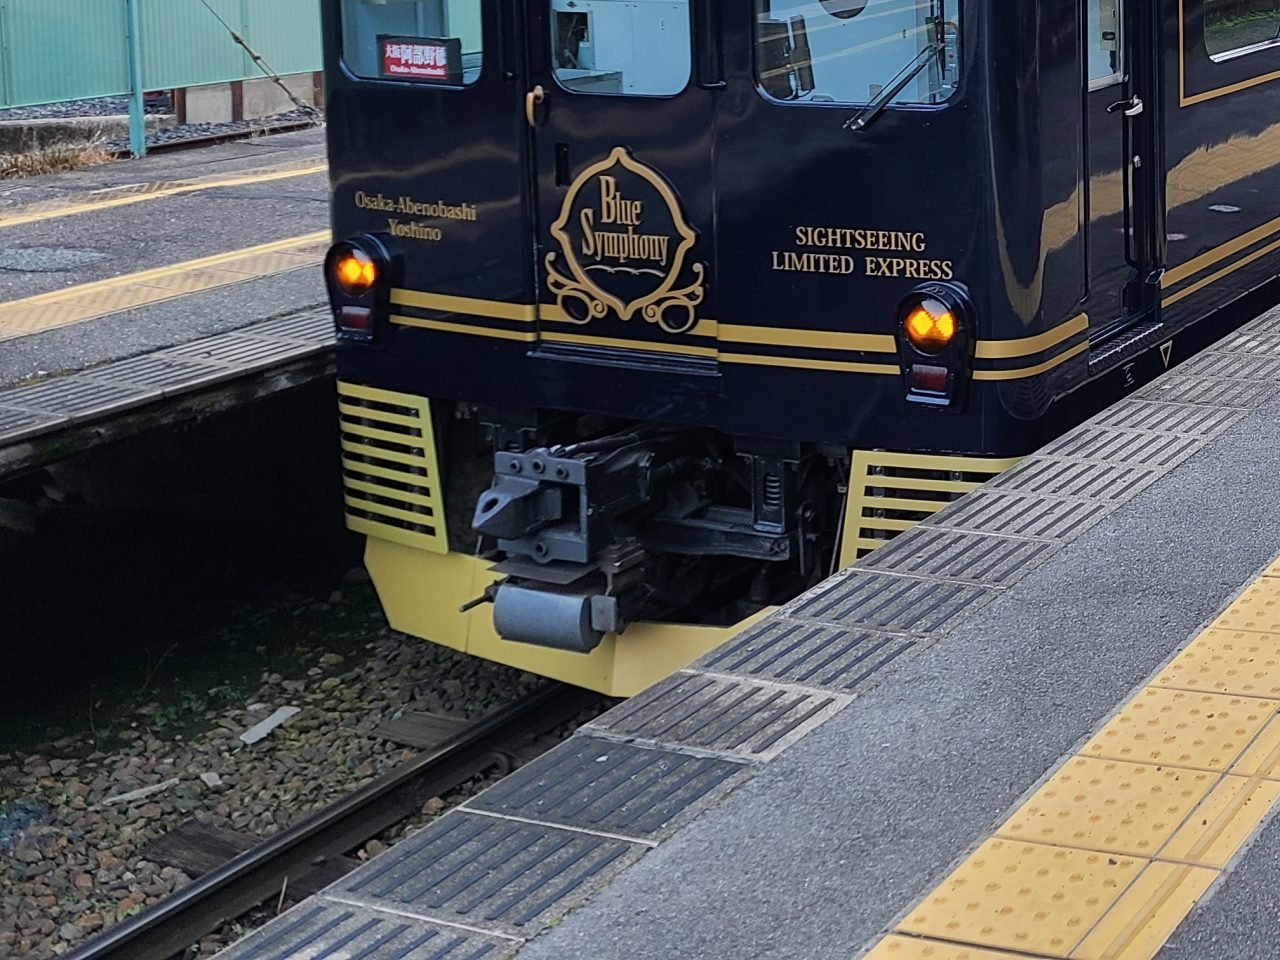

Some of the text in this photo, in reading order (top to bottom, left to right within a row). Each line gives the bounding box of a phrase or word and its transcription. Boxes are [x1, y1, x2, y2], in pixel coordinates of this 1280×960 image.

[354, 190, 477, 221] Osaka-Abenobashi
[599, 175, 642, 226] Blue
[388, 219, 442, 241] Yoshino
[580, 207, 669, 266] Symphony
[795, 226, 926, 252] SIGHTSEEING
[771, 251, 953, 280] LIMITED EXPRESS
